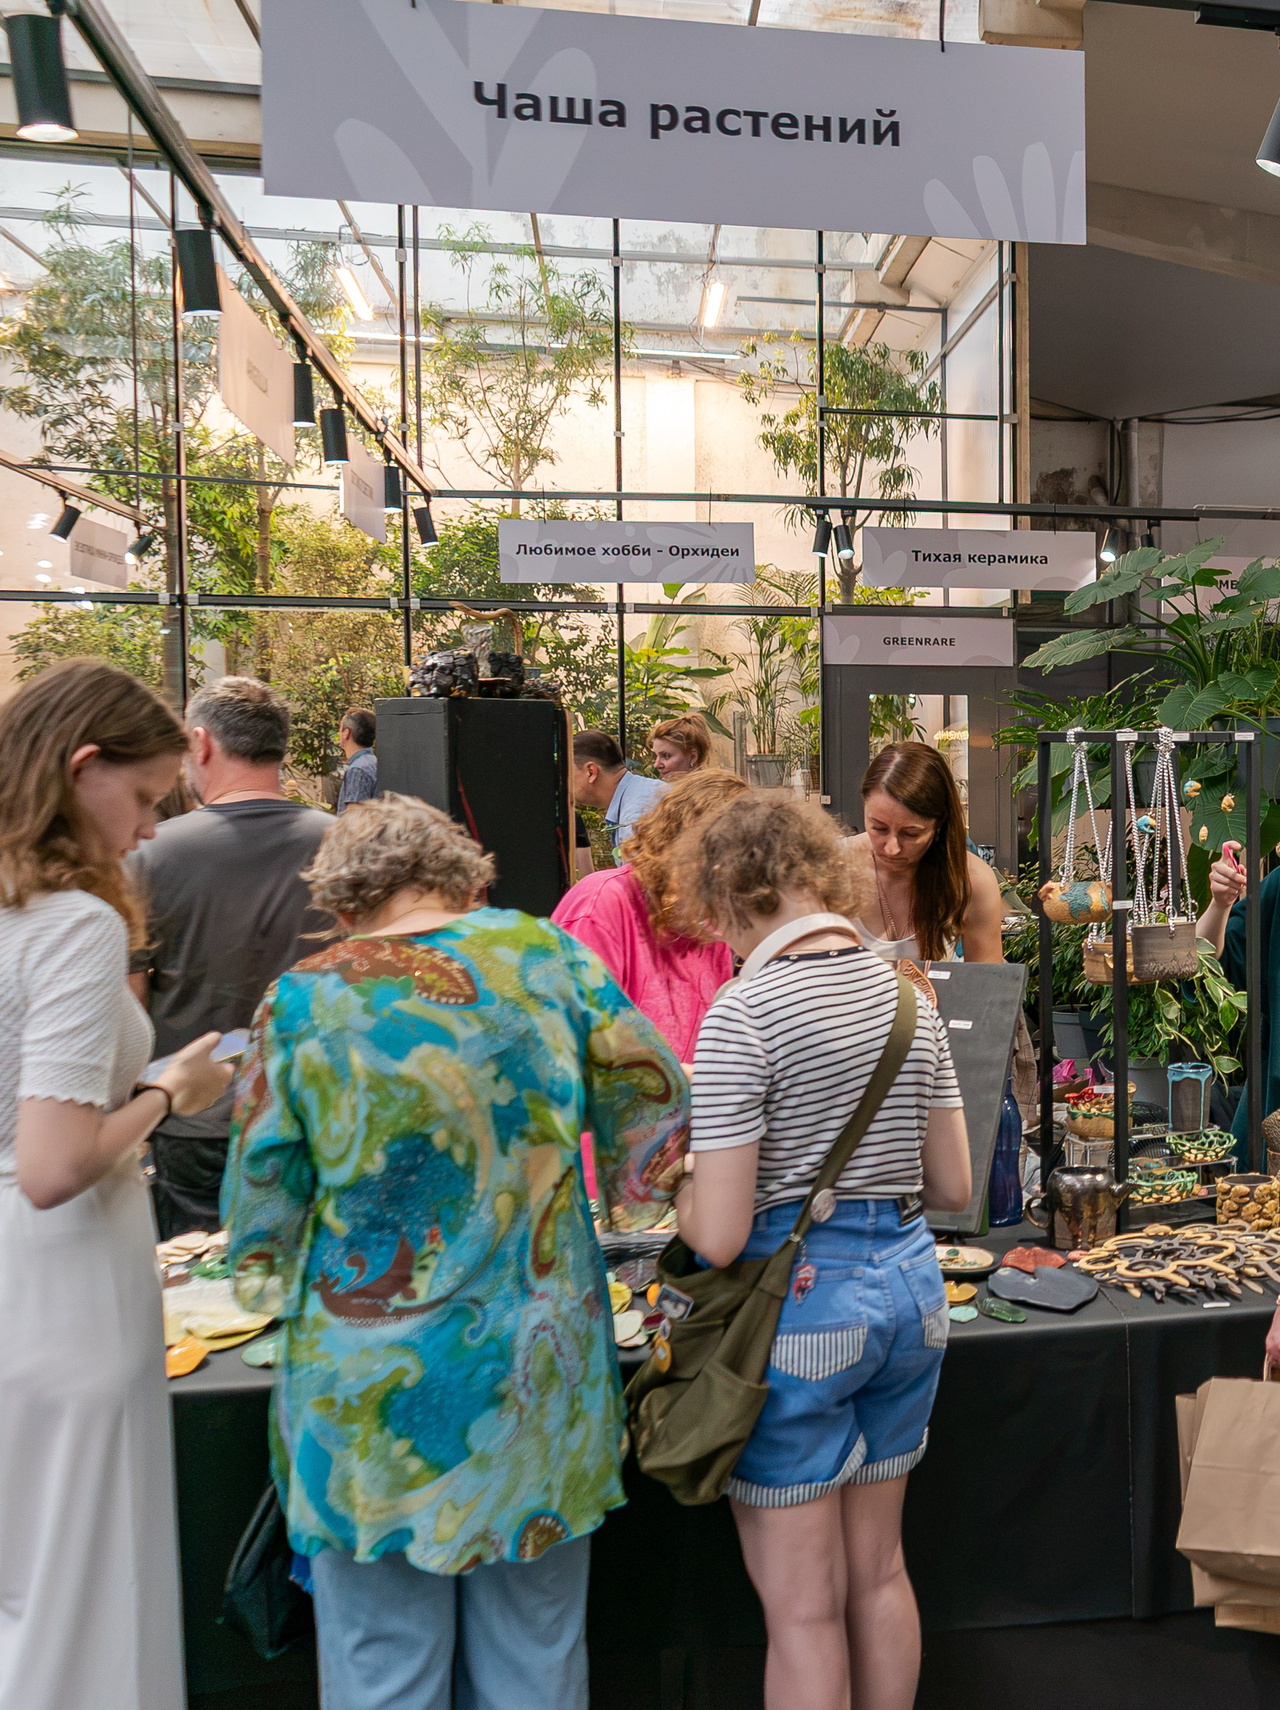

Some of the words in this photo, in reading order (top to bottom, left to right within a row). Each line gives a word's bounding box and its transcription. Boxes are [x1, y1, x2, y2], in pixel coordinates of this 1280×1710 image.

[473, 80, 627, 129] Чаша
[649, 101, 901, 147] растений
[515, 543, 596, 556] Любимое
[601, 544, 651, 557] хобби
[668, 545, 740, 559] Орхидеи
[911, 549, 962, 563] Тихая
[967, 551, 1049, 567] керамика
[882, 636, 956, 647] GREENRARE
